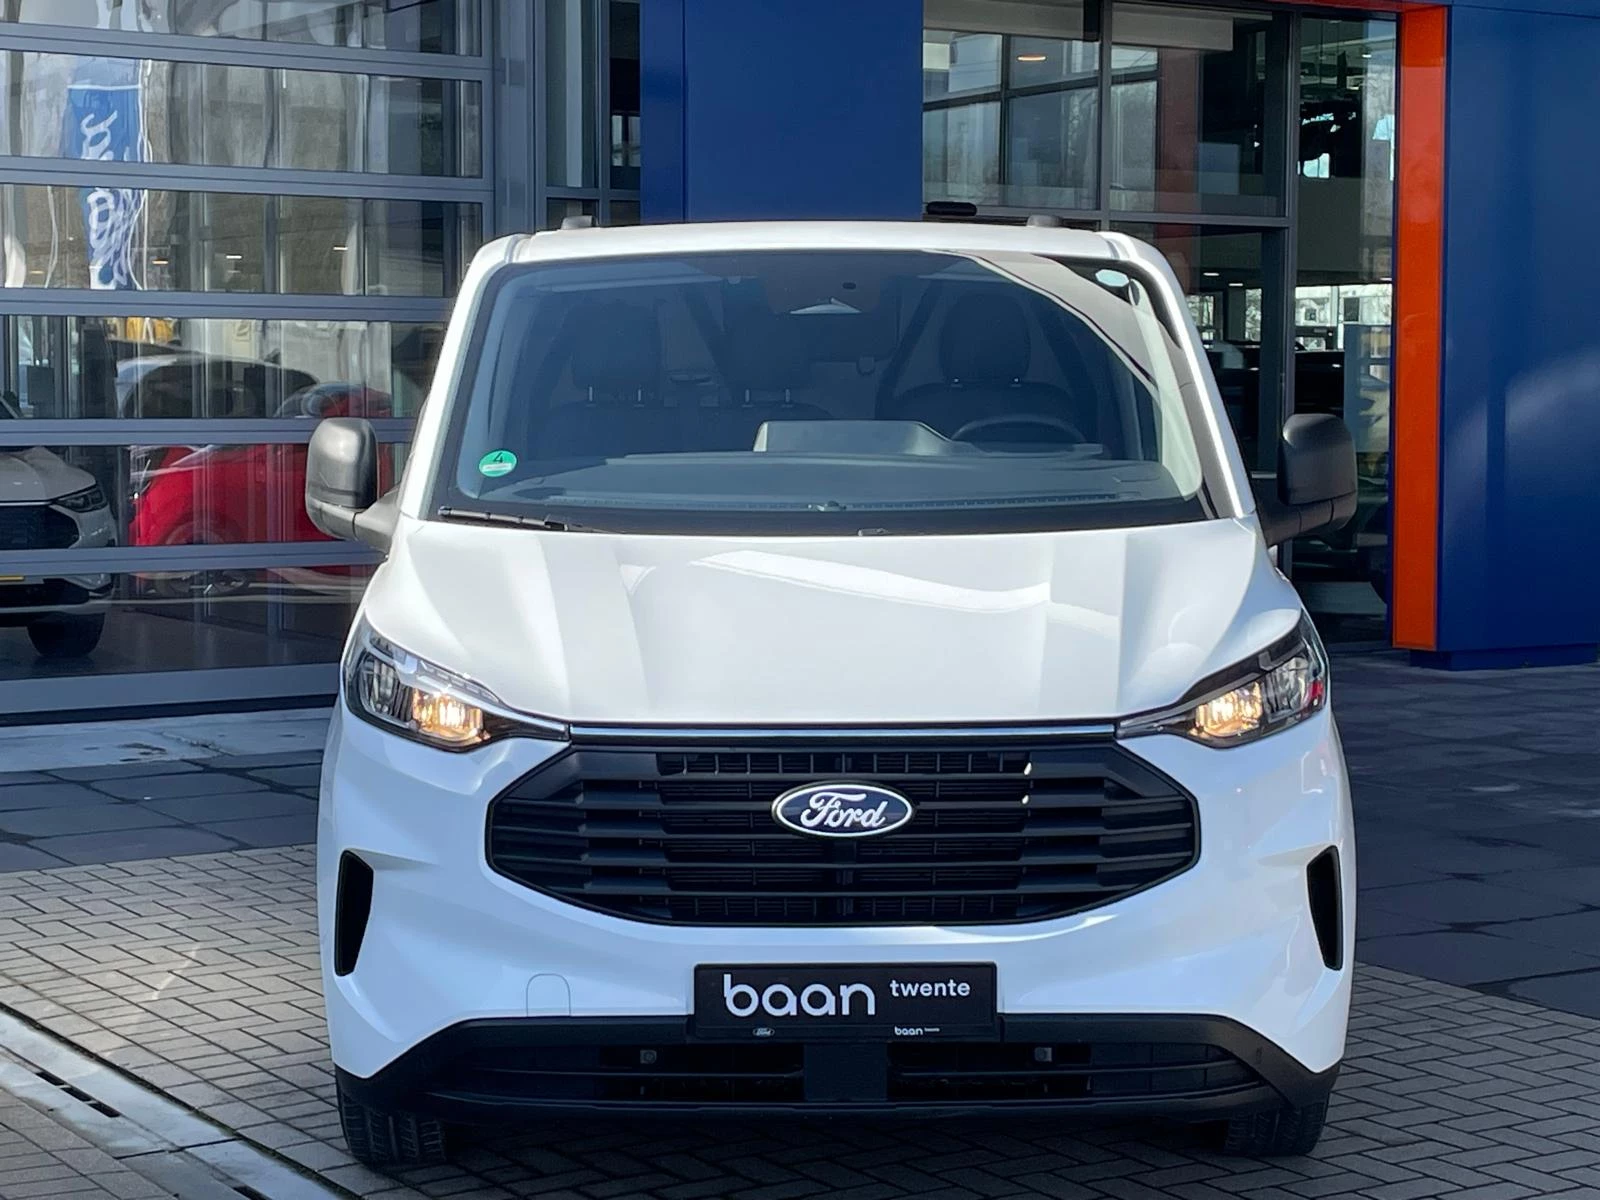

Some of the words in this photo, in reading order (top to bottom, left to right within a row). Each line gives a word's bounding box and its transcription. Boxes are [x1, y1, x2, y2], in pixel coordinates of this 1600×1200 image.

[493, 451, 504, 463] 4
[800, 791, 888, 828] Ford
[723, 973, 876, 1017] baan
[889, 979, 971, 998] twente
[894, 1026, 924, 1036] baan
